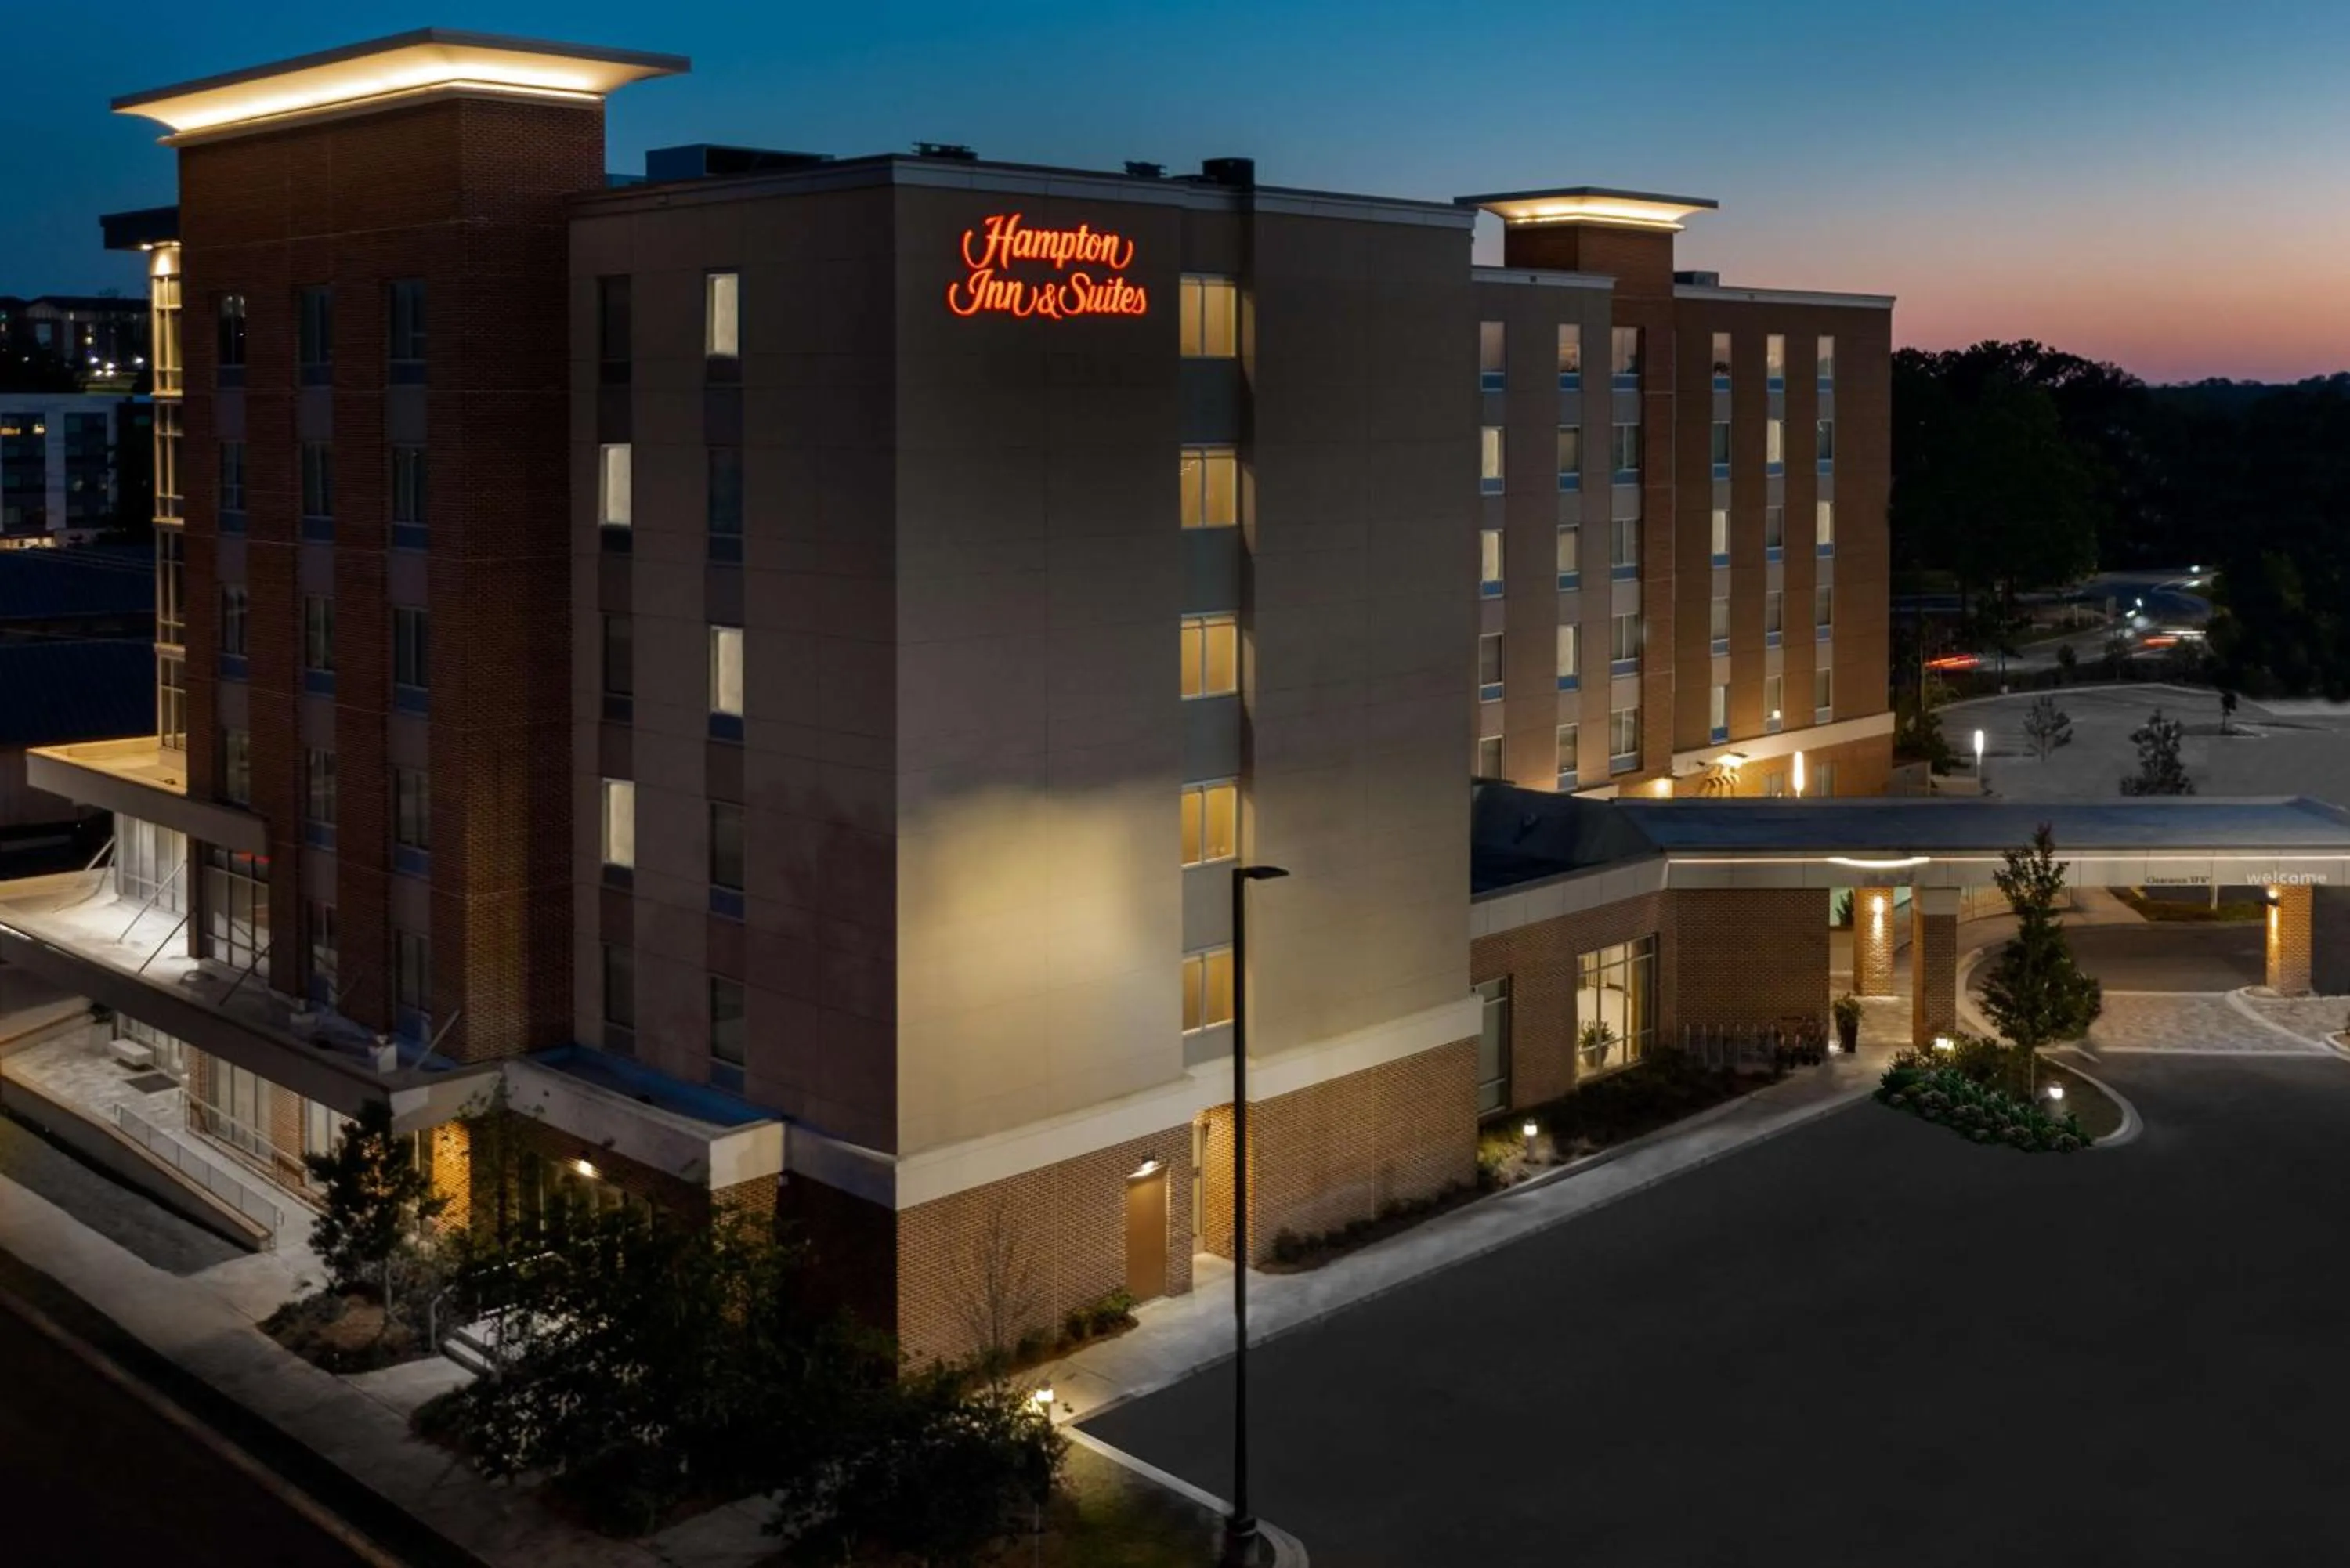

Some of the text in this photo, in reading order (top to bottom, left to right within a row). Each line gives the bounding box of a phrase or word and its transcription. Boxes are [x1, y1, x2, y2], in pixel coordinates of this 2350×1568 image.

[964, 214, 1134, 269] Hampton
[949, 269, 1147, 319] Inn & Suites
[2247, 870, 2328, 884] welcome
